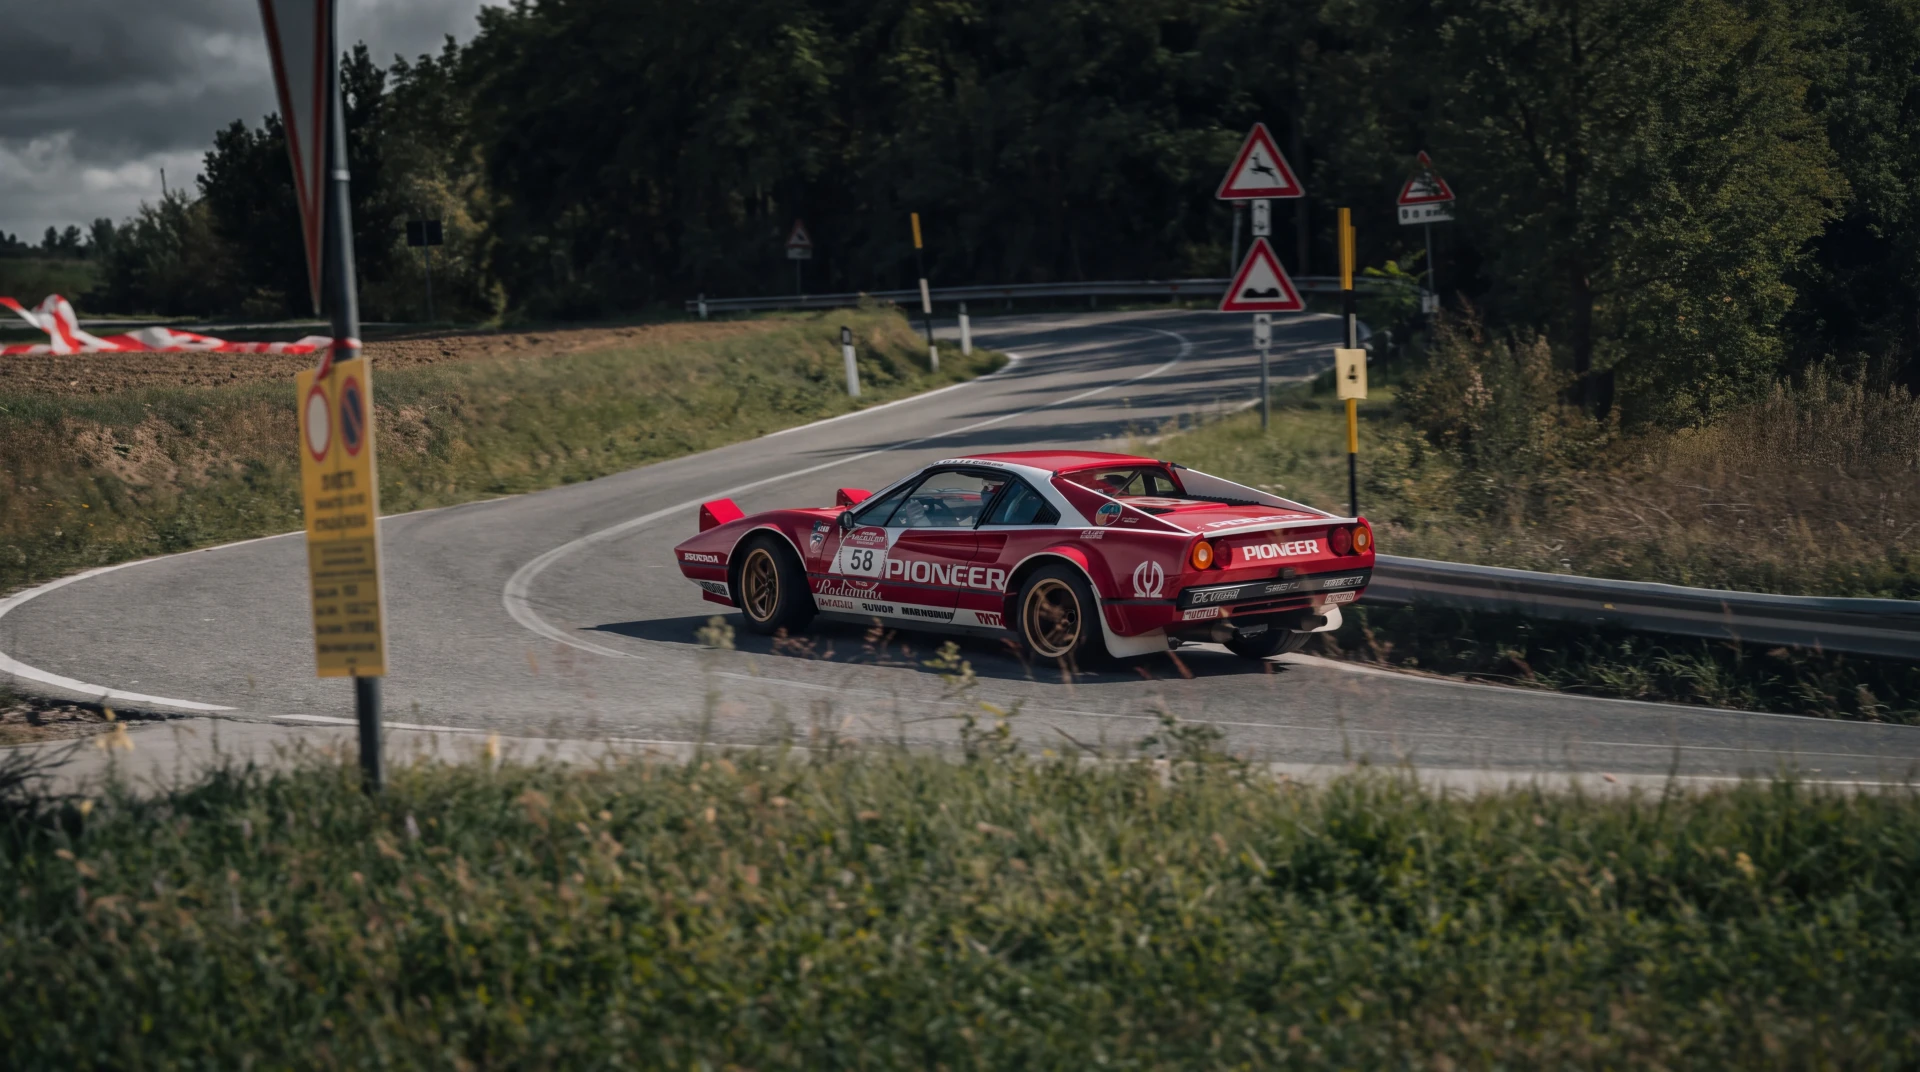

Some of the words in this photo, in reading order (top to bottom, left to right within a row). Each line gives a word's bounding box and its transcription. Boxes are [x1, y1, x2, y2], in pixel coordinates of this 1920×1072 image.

[850, 549, 874, 571] 58
[1242, 540, 1320, 561] PIONEER
[884, 559, 1006, 591] PIONEER
